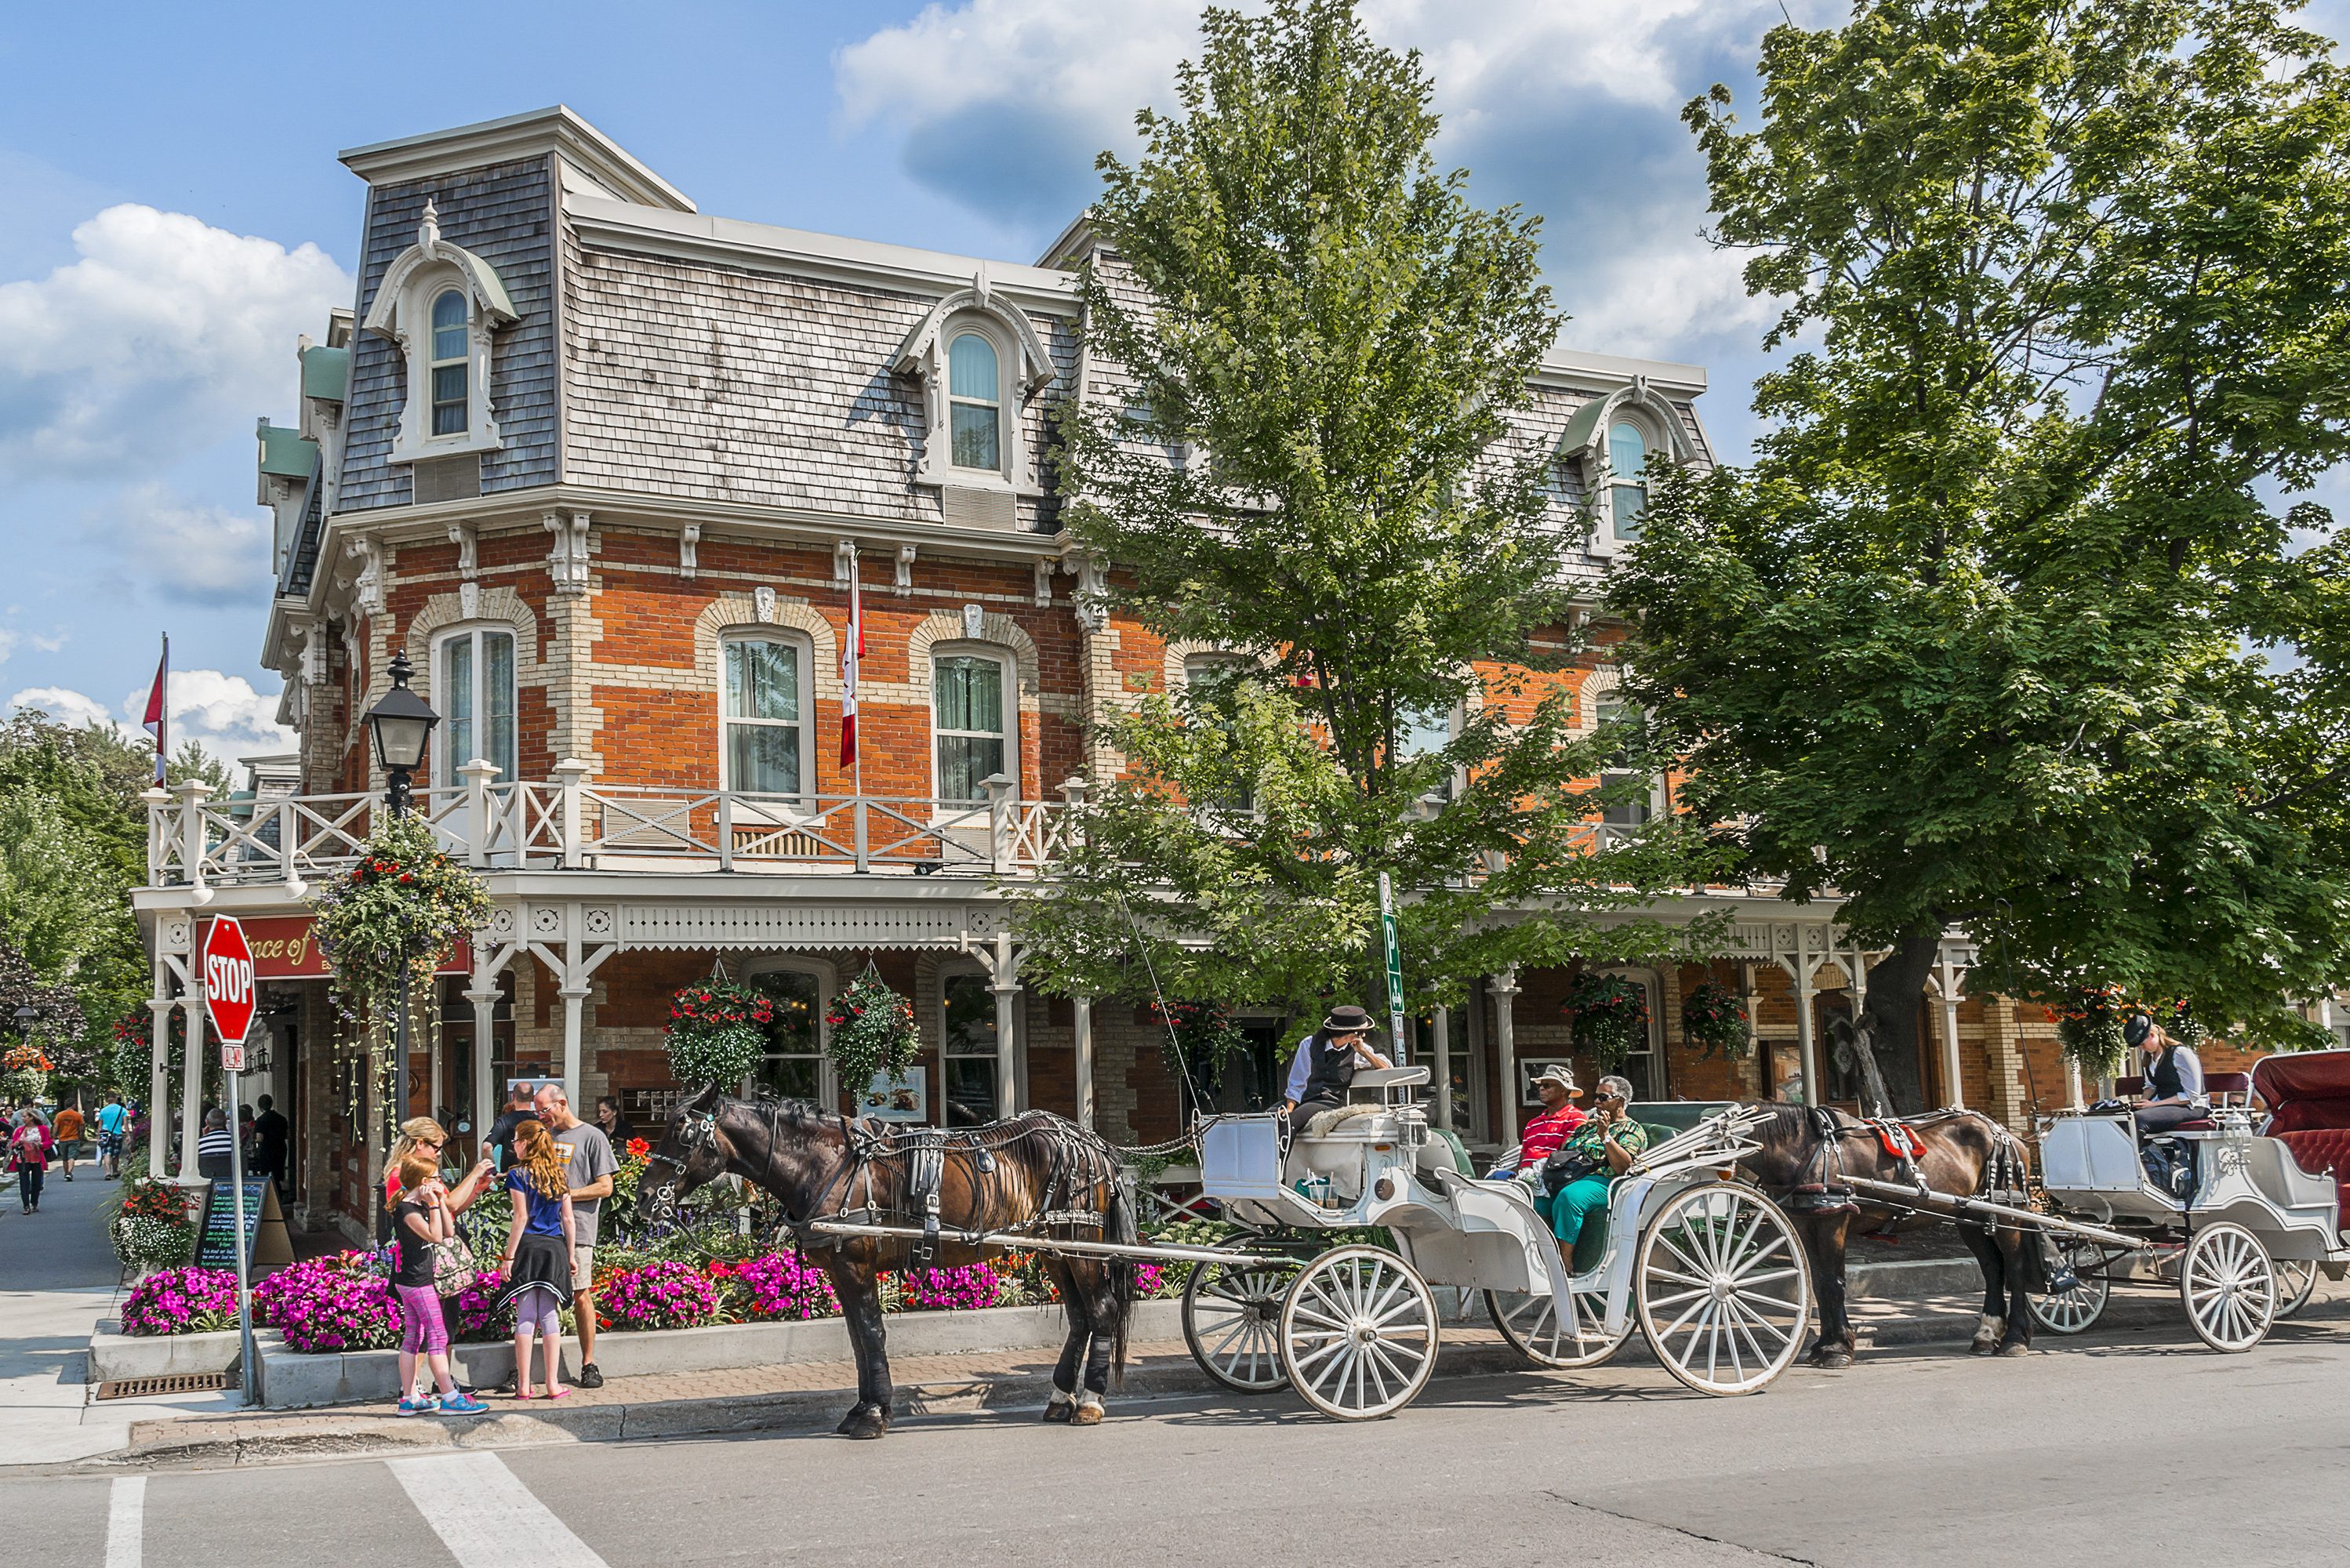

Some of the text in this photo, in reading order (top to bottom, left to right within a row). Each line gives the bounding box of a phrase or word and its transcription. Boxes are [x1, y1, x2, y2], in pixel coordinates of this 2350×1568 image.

[287, 928, 311, 966] of
[1385, 920, 1395, 964] P
[208, 953, 252, 1004] STOP
